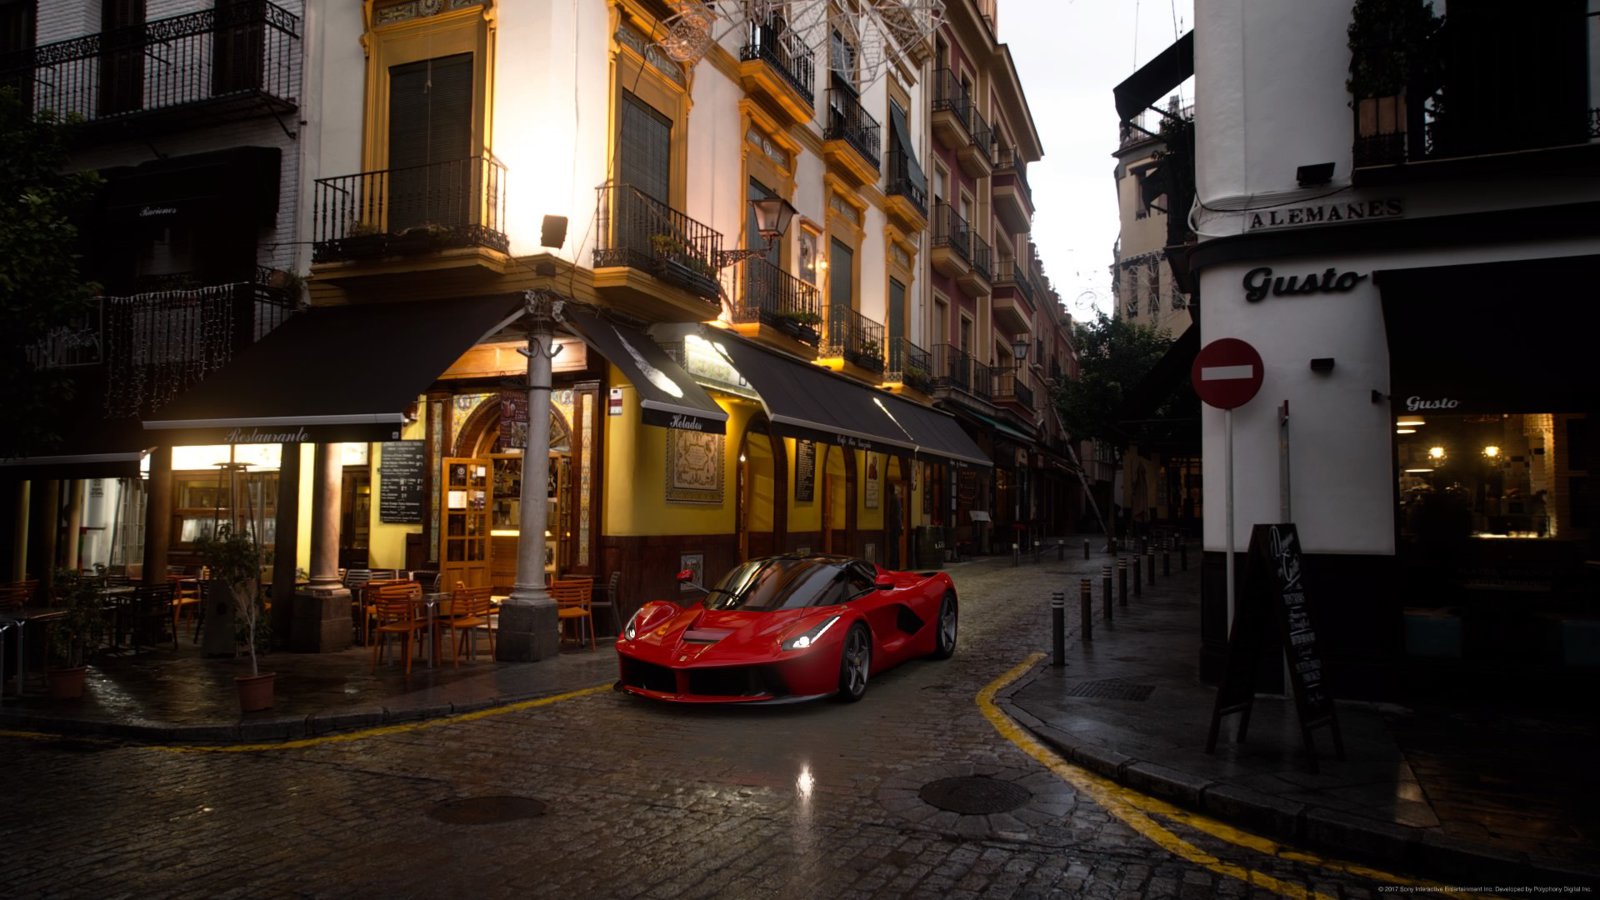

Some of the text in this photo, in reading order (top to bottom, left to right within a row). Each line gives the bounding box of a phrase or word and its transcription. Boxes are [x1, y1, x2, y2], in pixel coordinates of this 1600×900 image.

[1251, 199, 1402, 228] ALEMANES
[1243, 267, 1368, 302] Gusto
[1406, 395, 1462, 411] Gusto
[224, 426, 310, 442] Restaurante
